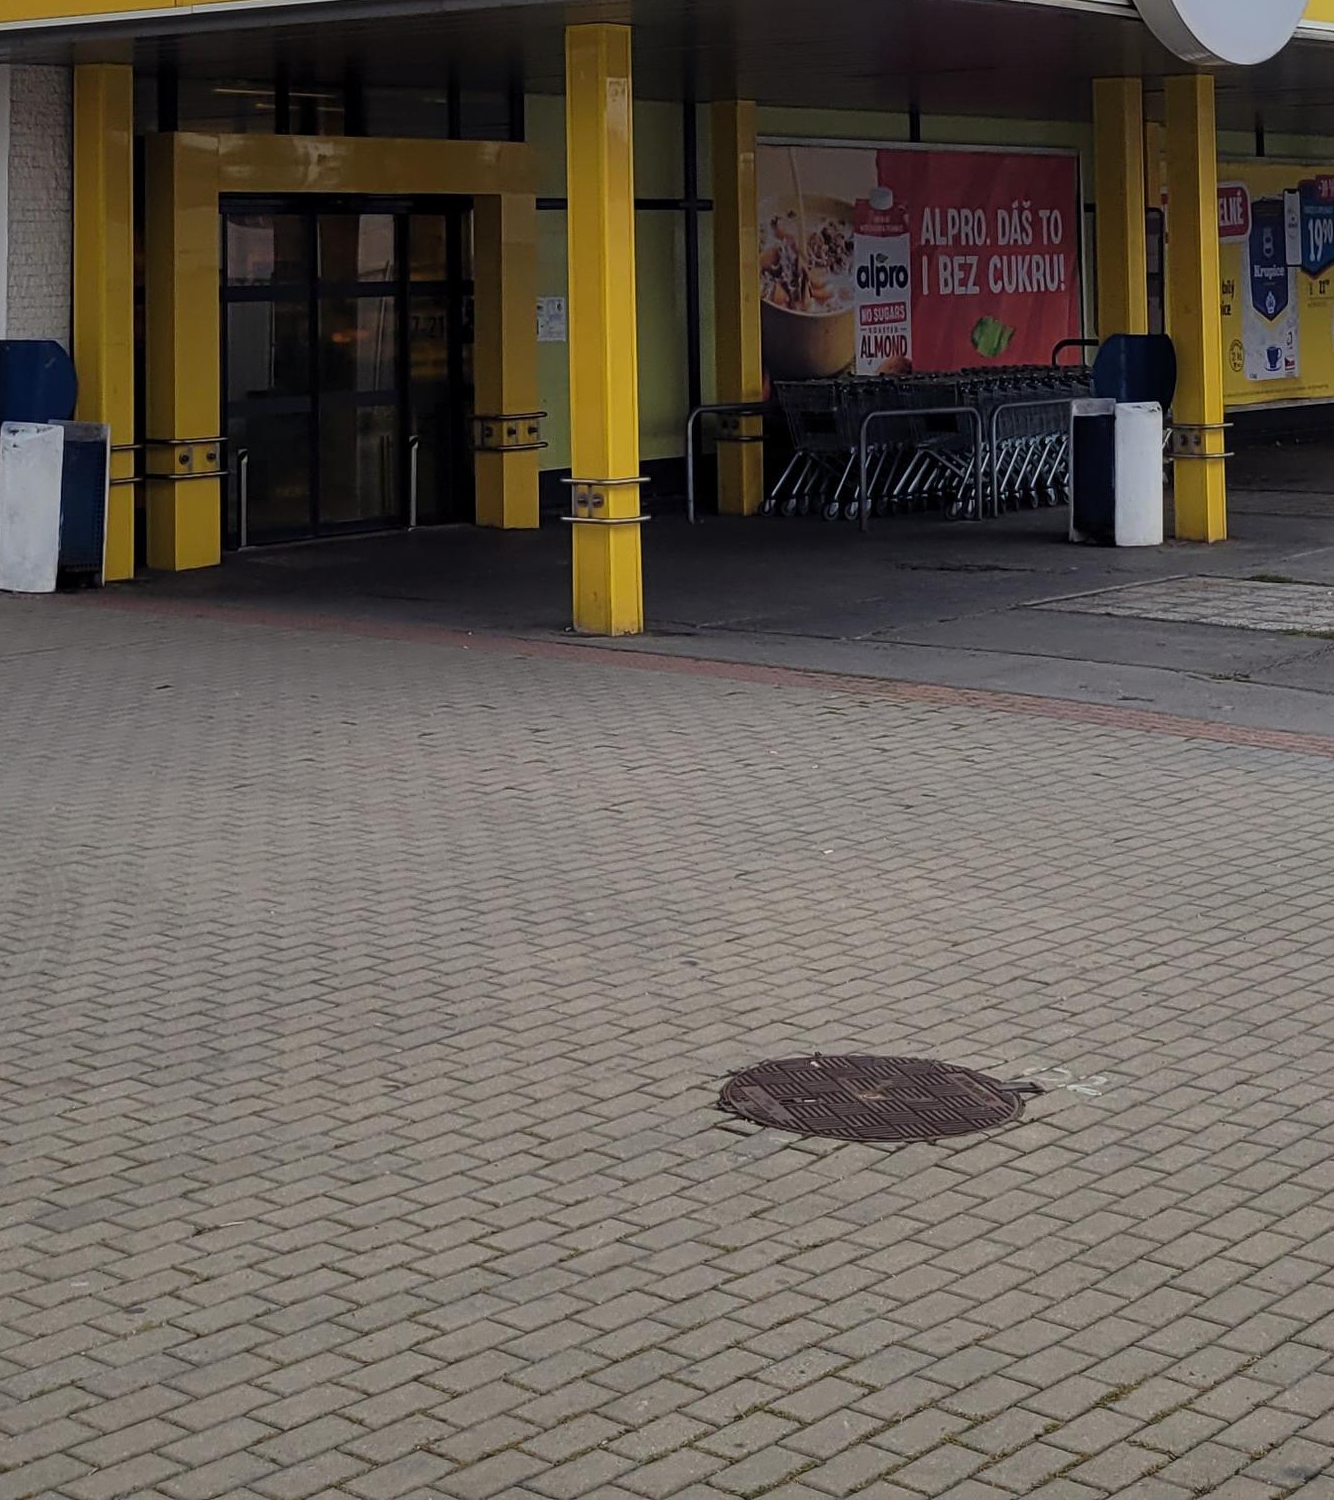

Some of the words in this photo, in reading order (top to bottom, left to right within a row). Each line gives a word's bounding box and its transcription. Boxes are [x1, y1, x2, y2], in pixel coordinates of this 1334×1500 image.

[920, 208, 990, 246] ALPRO.
[997, 199, 1034, 246] DÁŠ
[1038, 209, 1063, 245] TO
[856, 253, 909, 296] alpro
[921, 255, 929, 295] I
[938, 255, 979, 295] BEZ
[988, 253, 1066, 293] CUKRU!
[873, 304, 906, 322] SUGARS
[860, 334, 908, 358] ALMOND
